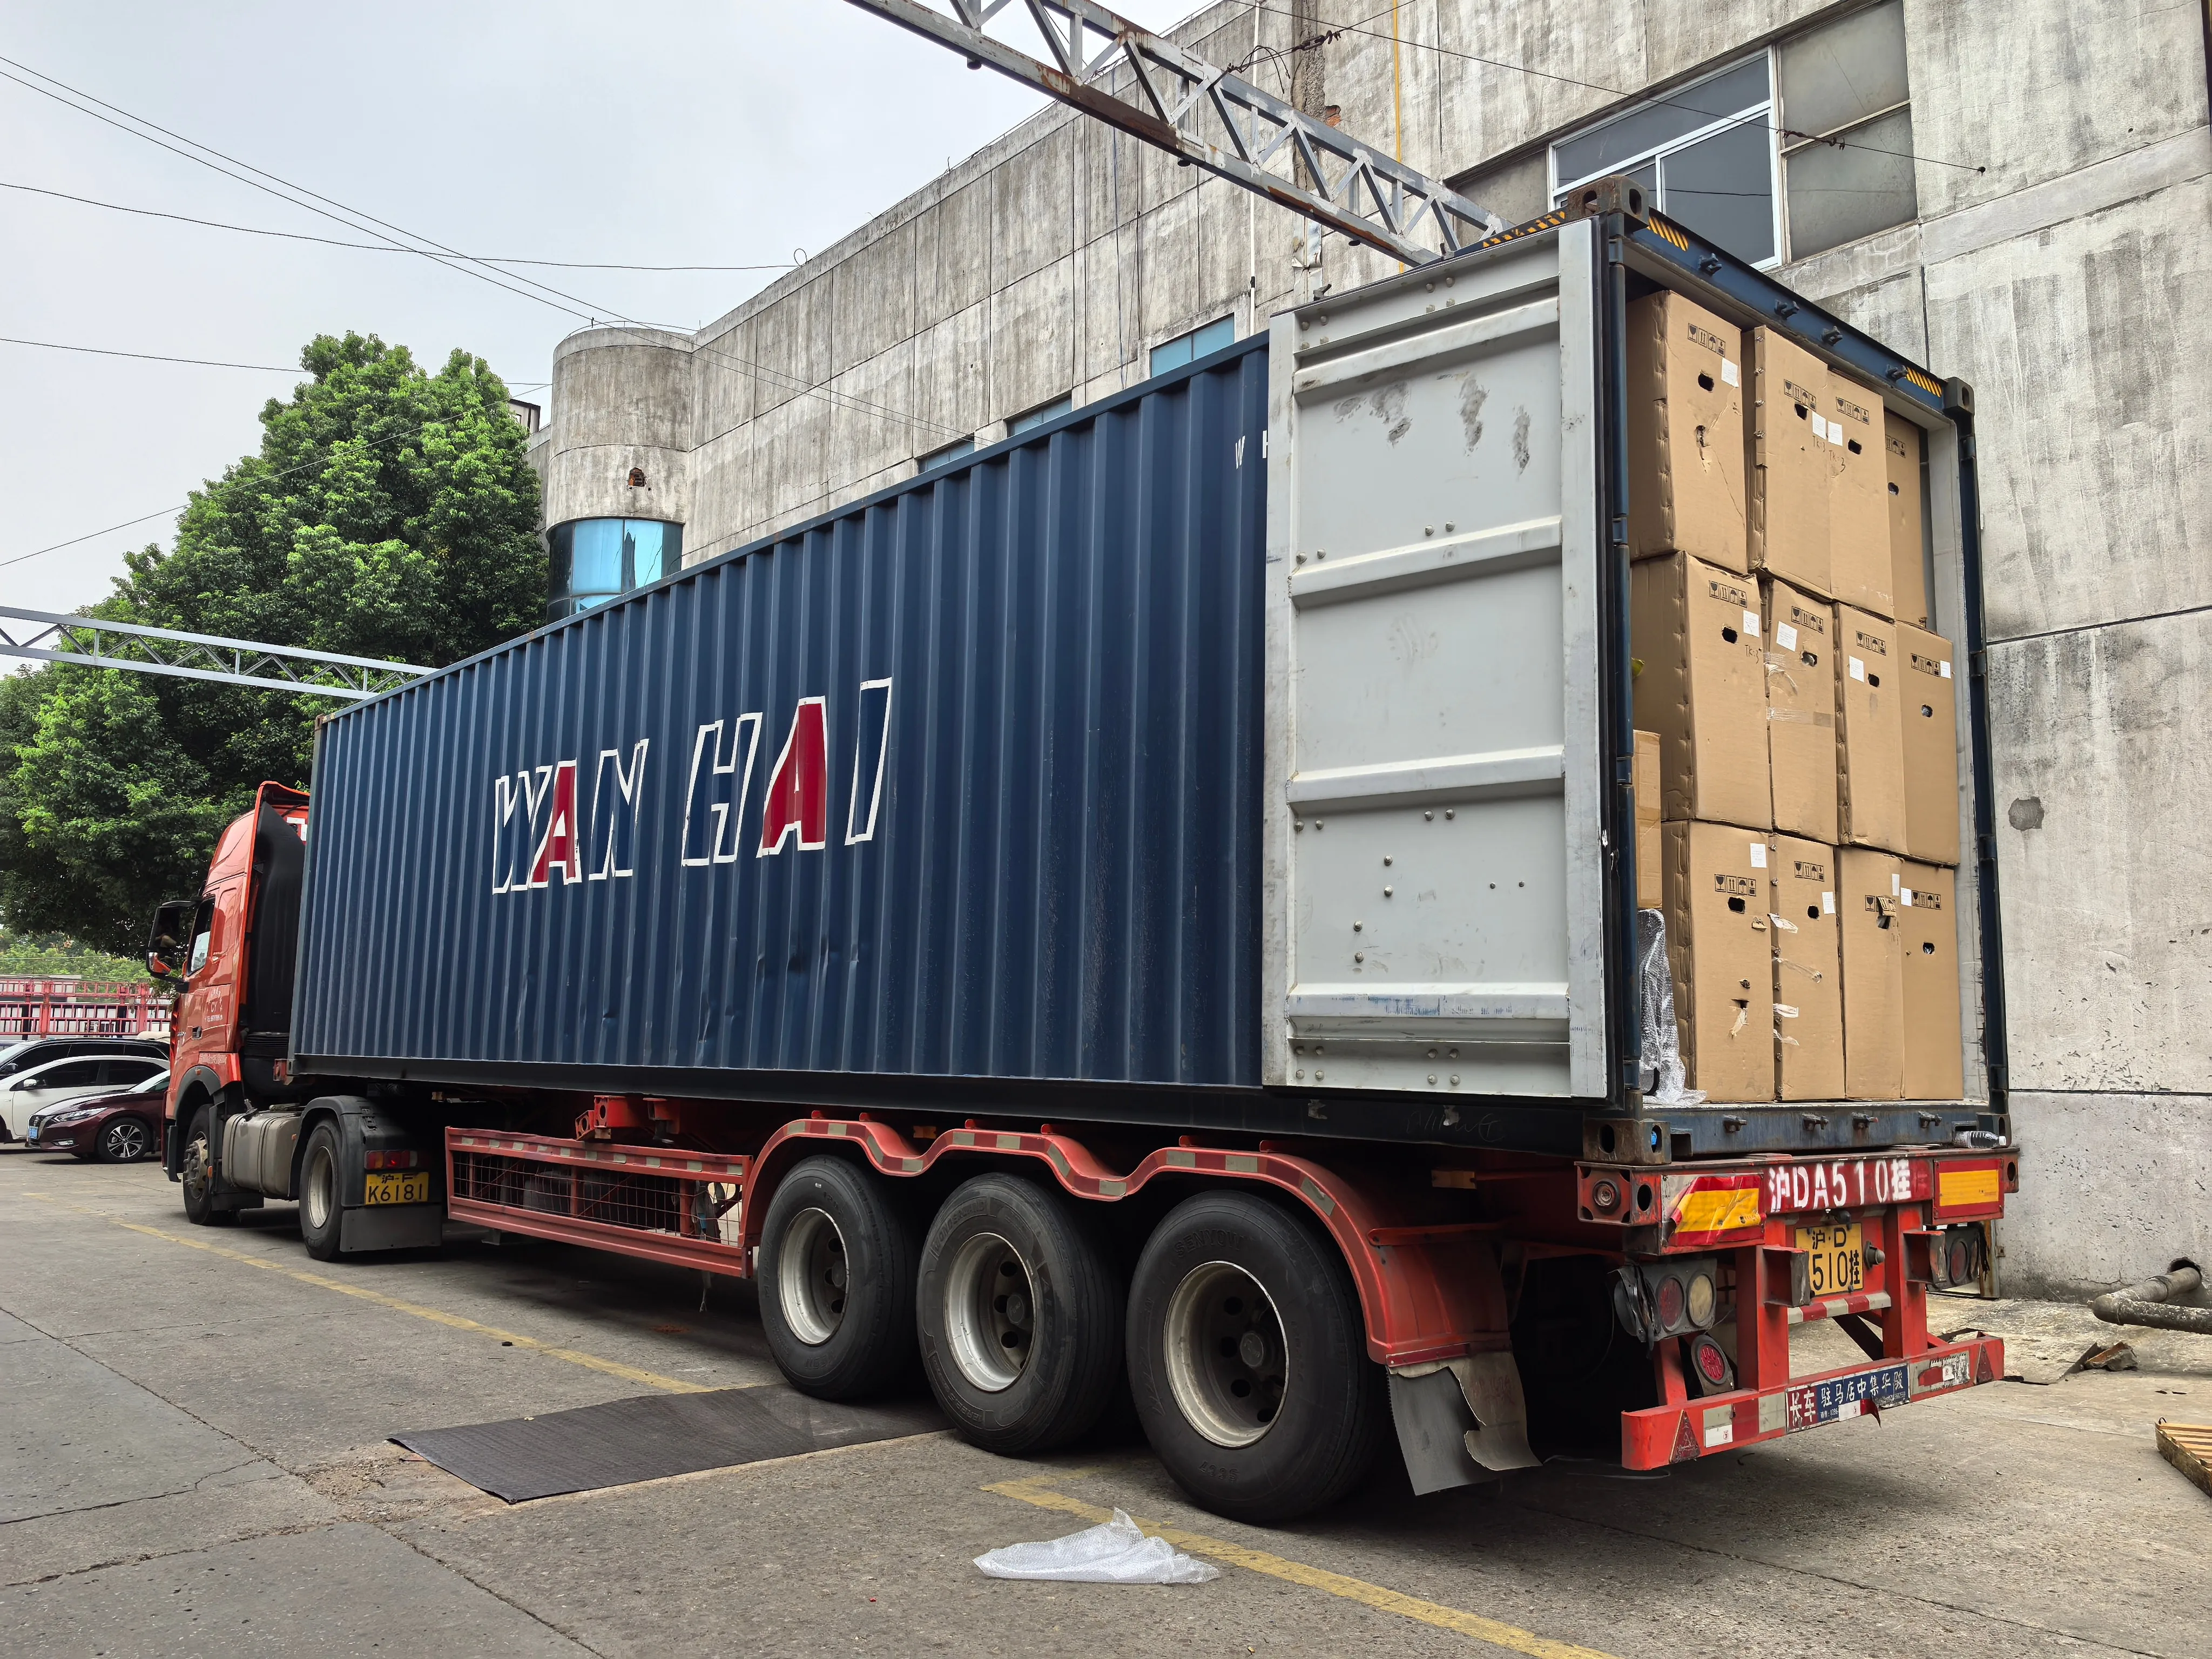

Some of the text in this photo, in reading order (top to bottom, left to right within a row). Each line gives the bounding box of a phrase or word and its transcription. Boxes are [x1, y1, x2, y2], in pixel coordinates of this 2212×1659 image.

[492, 676, 893, 895] WAN HAI
[368, 1183, 422, 1203] K6181
[1769, 1158, 1912, 1213] 沪DA510挂
[1812, 1249, 1860, 1291] 510挂
[1820, 1370, 1904, 1407] 驻马店中集华骏
